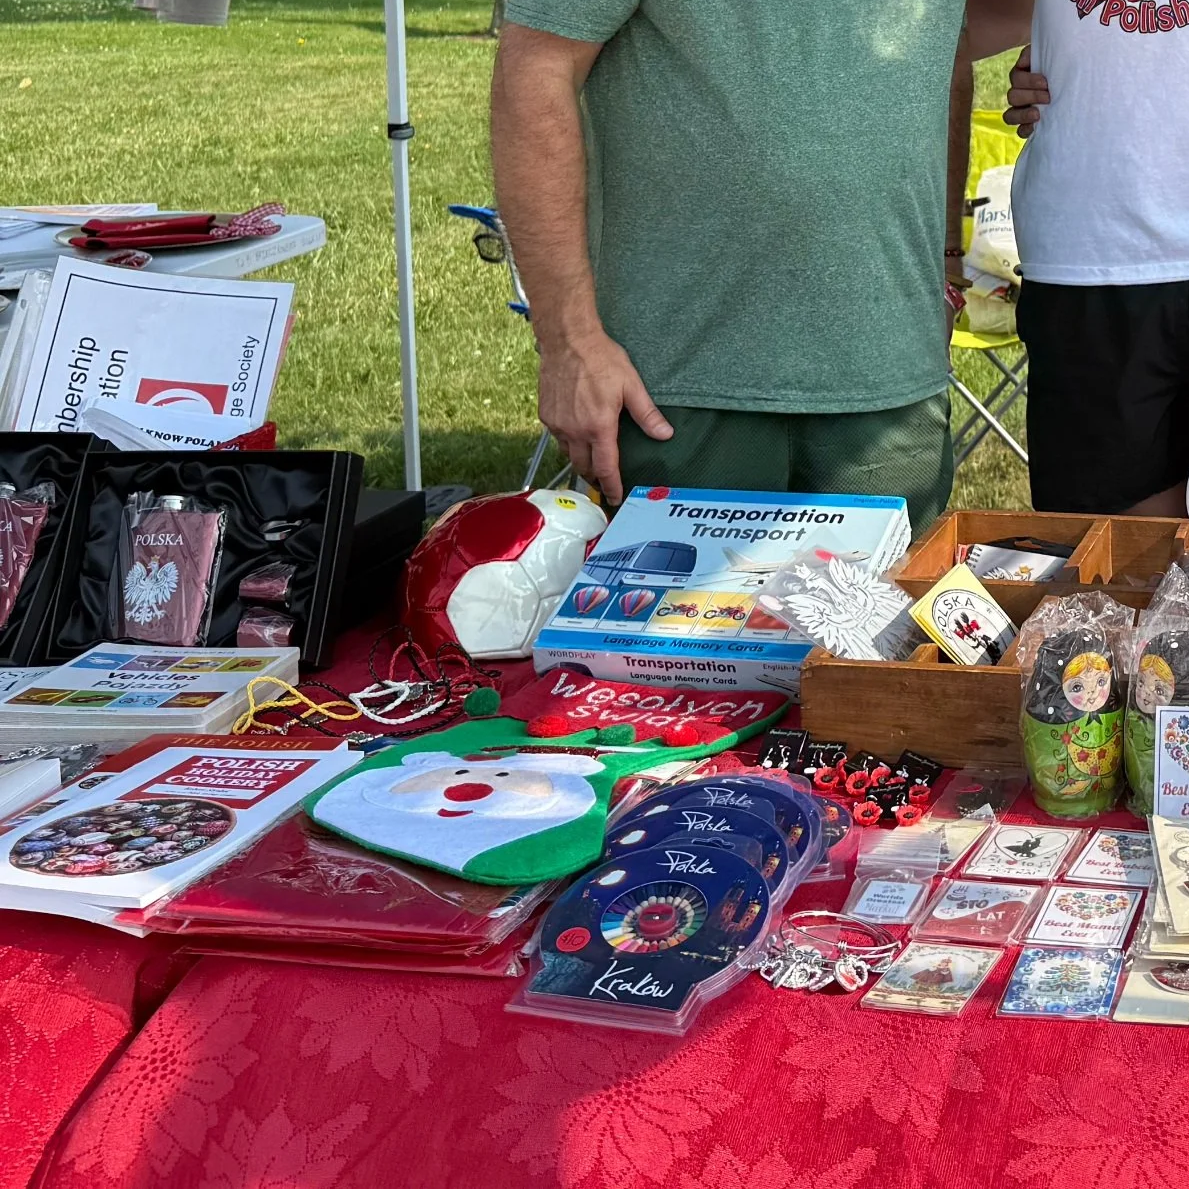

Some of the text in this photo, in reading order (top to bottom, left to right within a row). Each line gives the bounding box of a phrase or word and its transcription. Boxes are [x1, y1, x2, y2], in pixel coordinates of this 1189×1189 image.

[232, 335, 260, 393] Society
[668, 503, 845, 525] Transportation
[135, 532, 184, 546] POLSKA
[691, 522, 807, 544] Transport
[603, 635, 765, 653] Language Memory Cards
[548, 650, 597, 660] WORDPLAY
[623, 655, 737, 673] Transportation
[108, 672, 200, 681] Vehicles
[630, 672, 738, 685] Language Memory Cards
[91, 680, 190, 690] Pojazdy
[171, 737, 313, 750] THE POLISH
[194, 757, 306, 771] POLISH
[184, 768, 284, 779] HOLIDAY
[165, 775, 278, 789] COOKERY
[1161, 781, 1188, 798] Best
[696, 787, 755, 807] Polska
[674, 811, 735, 832] Polska
[656, 850, 717, 874] Polska
[956, 899, 989, 910] STO
[976, 910, 1006, 921] LAT
[1044, 919, 1075, 928] Best
[561, 932, 586, 947] $10
[589, 959, 674, 1000] Kraków
